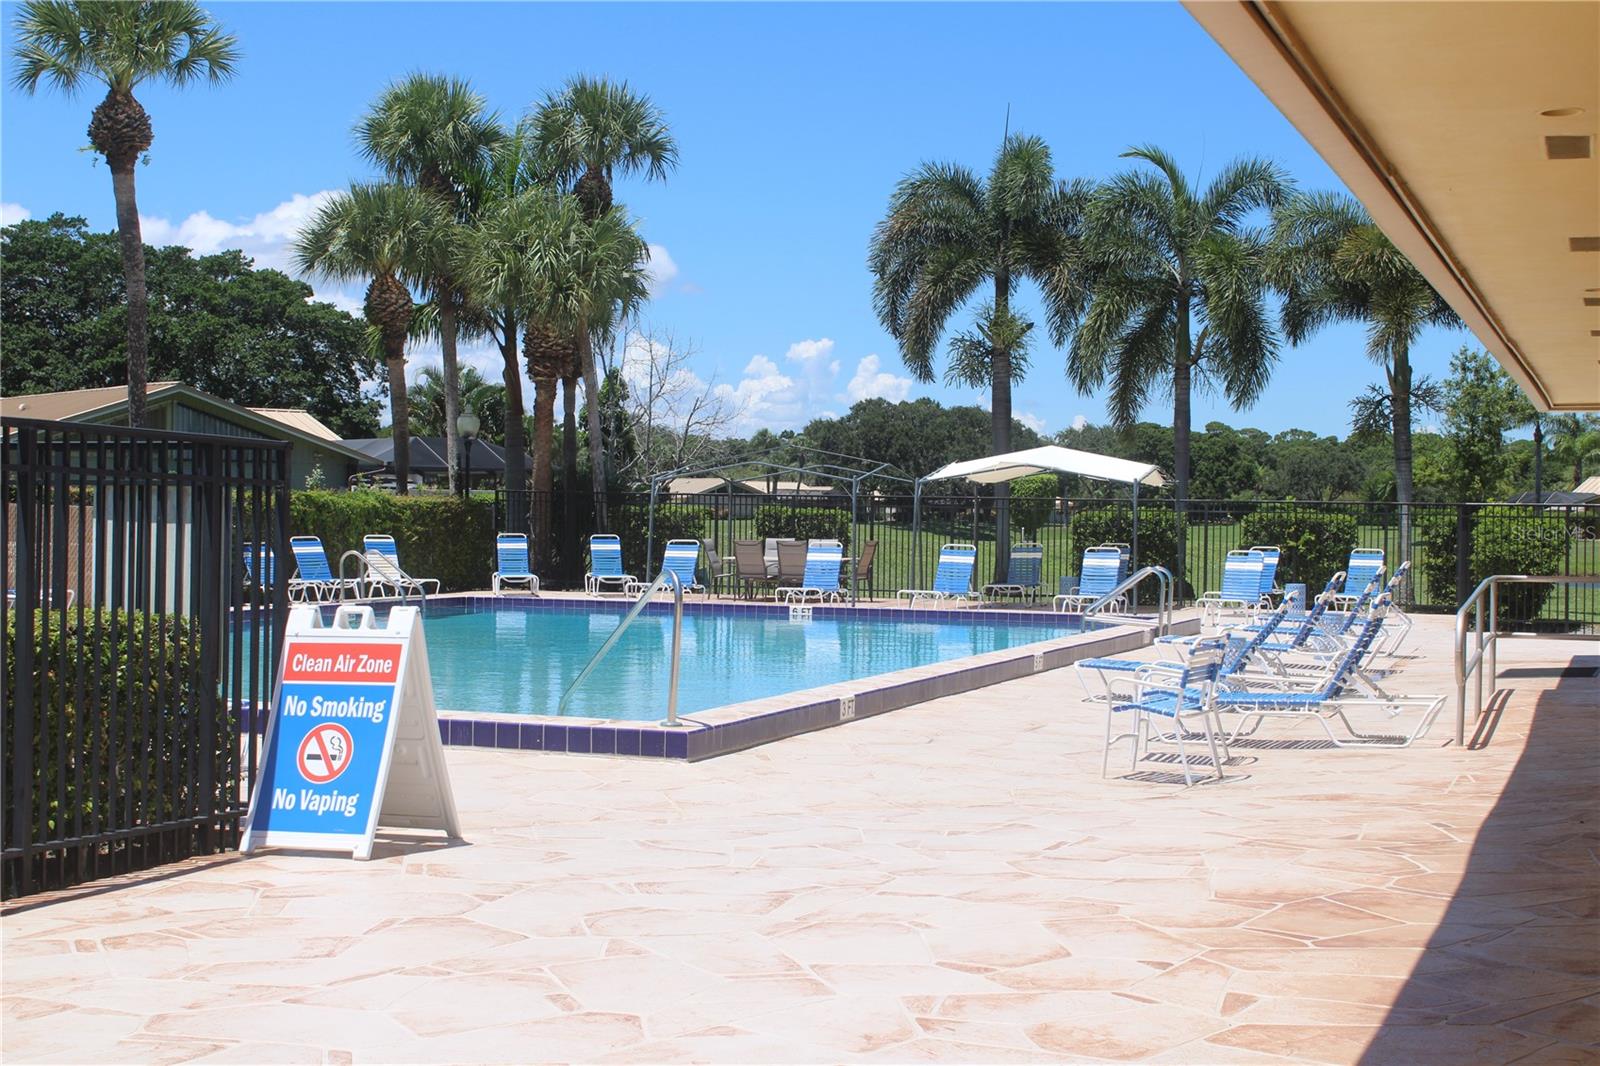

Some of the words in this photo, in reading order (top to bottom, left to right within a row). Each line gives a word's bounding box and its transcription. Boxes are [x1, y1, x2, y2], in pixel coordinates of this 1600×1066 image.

[292, 653, 332, 672] Clean
[333, 654, 356, 673] Air
[357, 655, 393, 673] Zone
[283, 695, 308, 717] No
[310, 696, 387, 723] Smoking
[272, 788, 296, 810] No
[299, 789, 360, 816] Vaping
